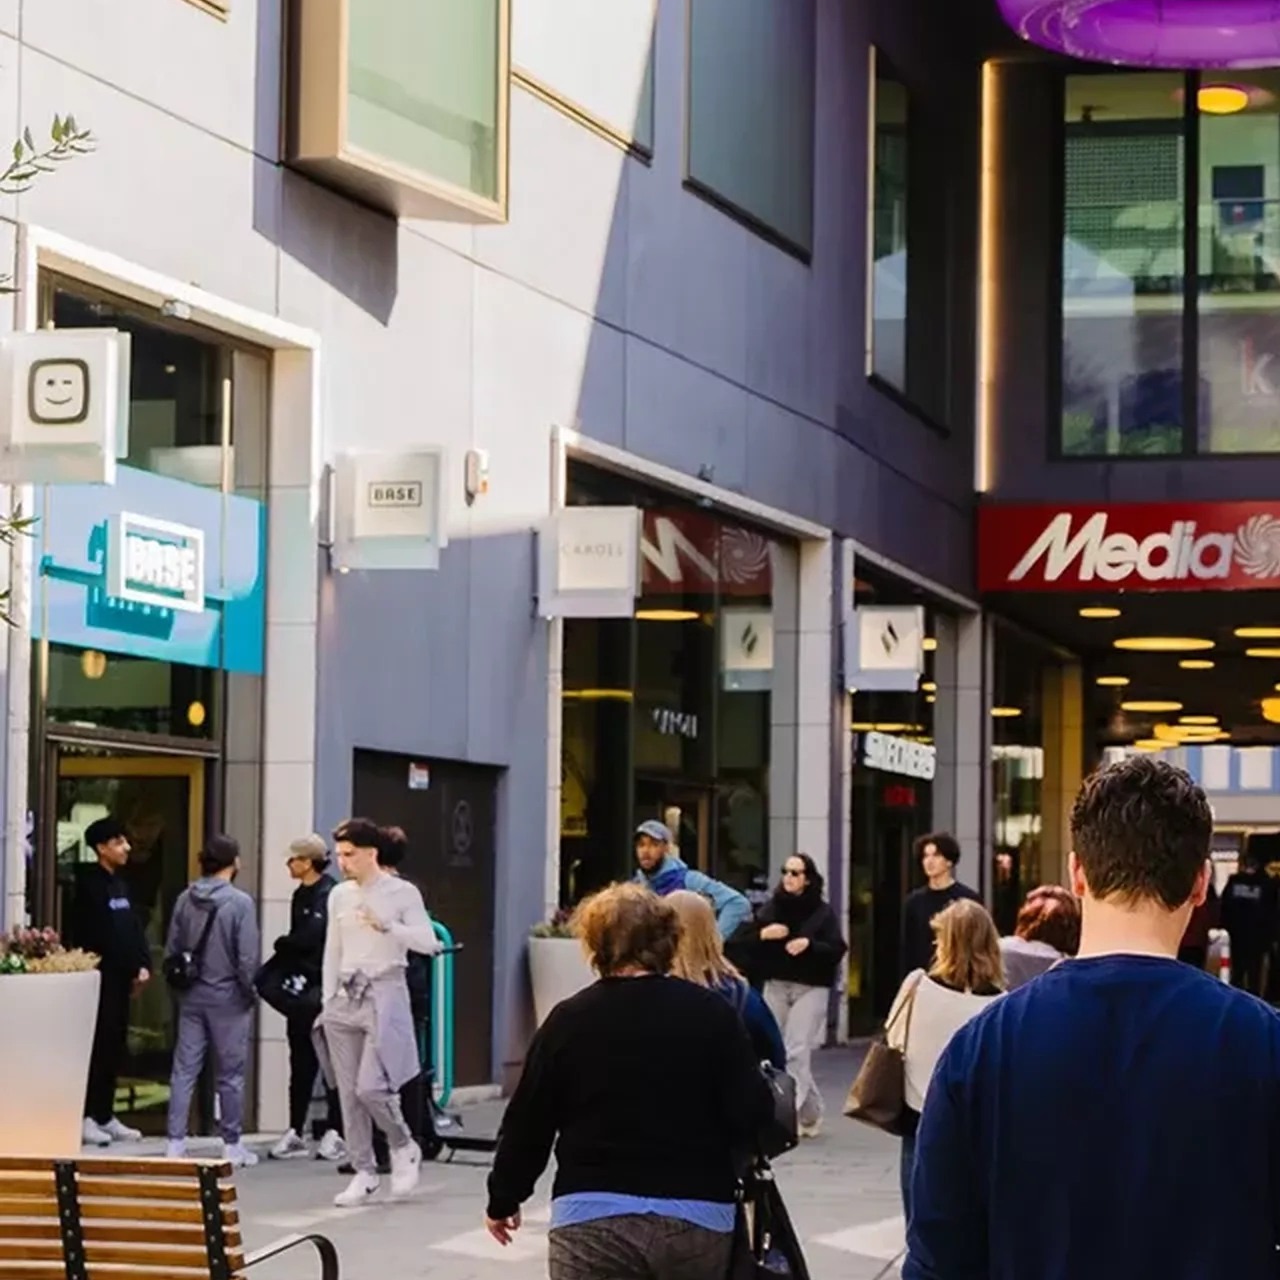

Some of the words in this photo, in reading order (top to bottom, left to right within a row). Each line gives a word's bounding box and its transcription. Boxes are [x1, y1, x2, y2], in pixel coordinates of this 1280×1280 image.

[374, 486, 417, 501] BASE
[126, 535, 197, 591] BASE
[1008, 512, 1235, 582] Media
